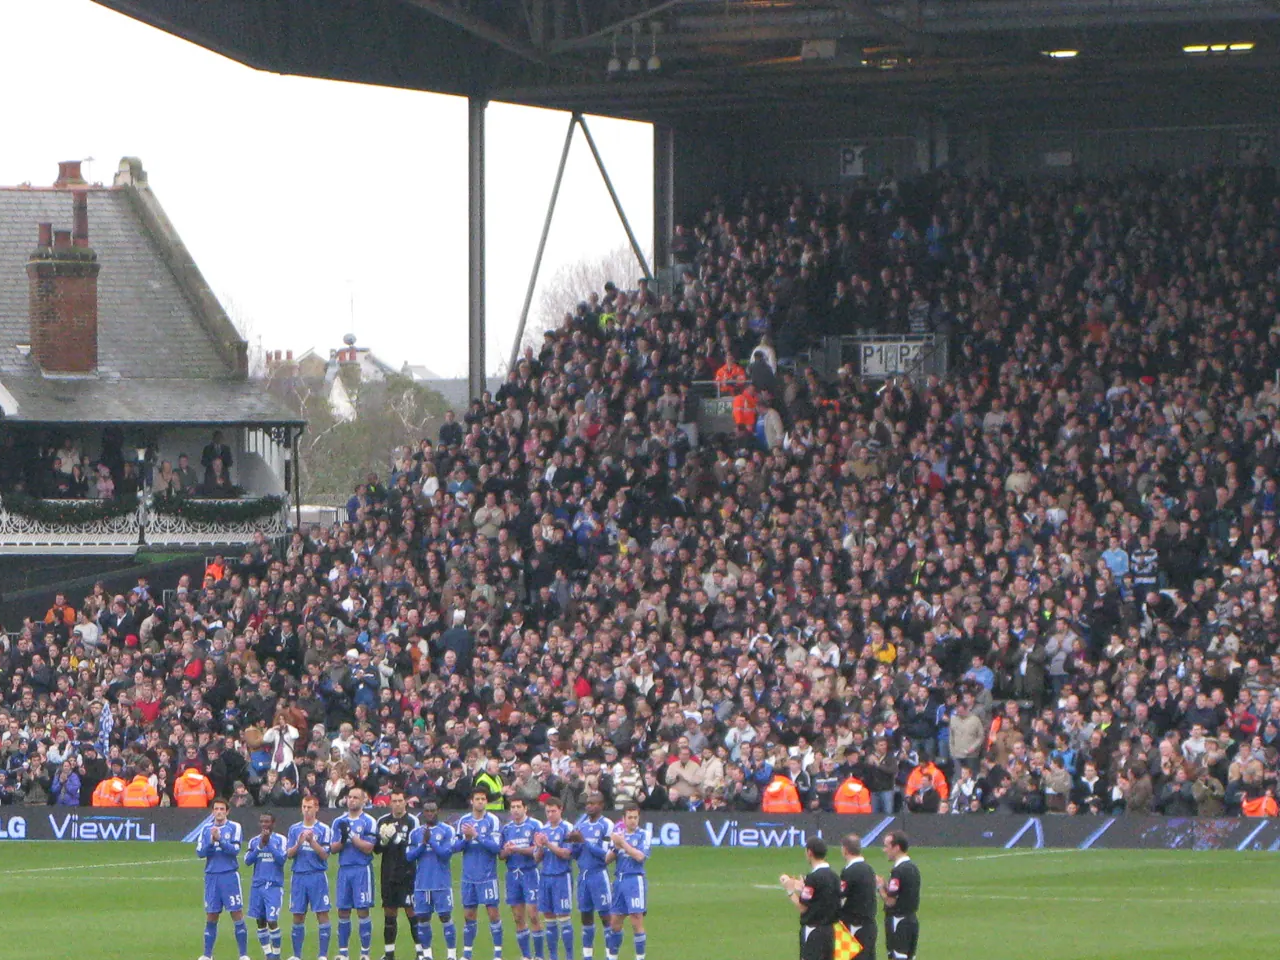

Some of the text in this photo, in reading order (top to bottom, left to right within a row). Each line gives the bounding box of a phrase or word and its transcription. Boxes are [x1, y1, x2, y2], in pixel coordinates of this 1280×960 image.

[863, 345, 884, 365] P1
[644, 822, 680, 846] LG
[484, 888, 494, 899] 13
[229, 895, 241, 906] 35
[323, 895, 330, 906] 9
[560, 898, 569, 909] 18
[631, 897, 640, 908] 10
